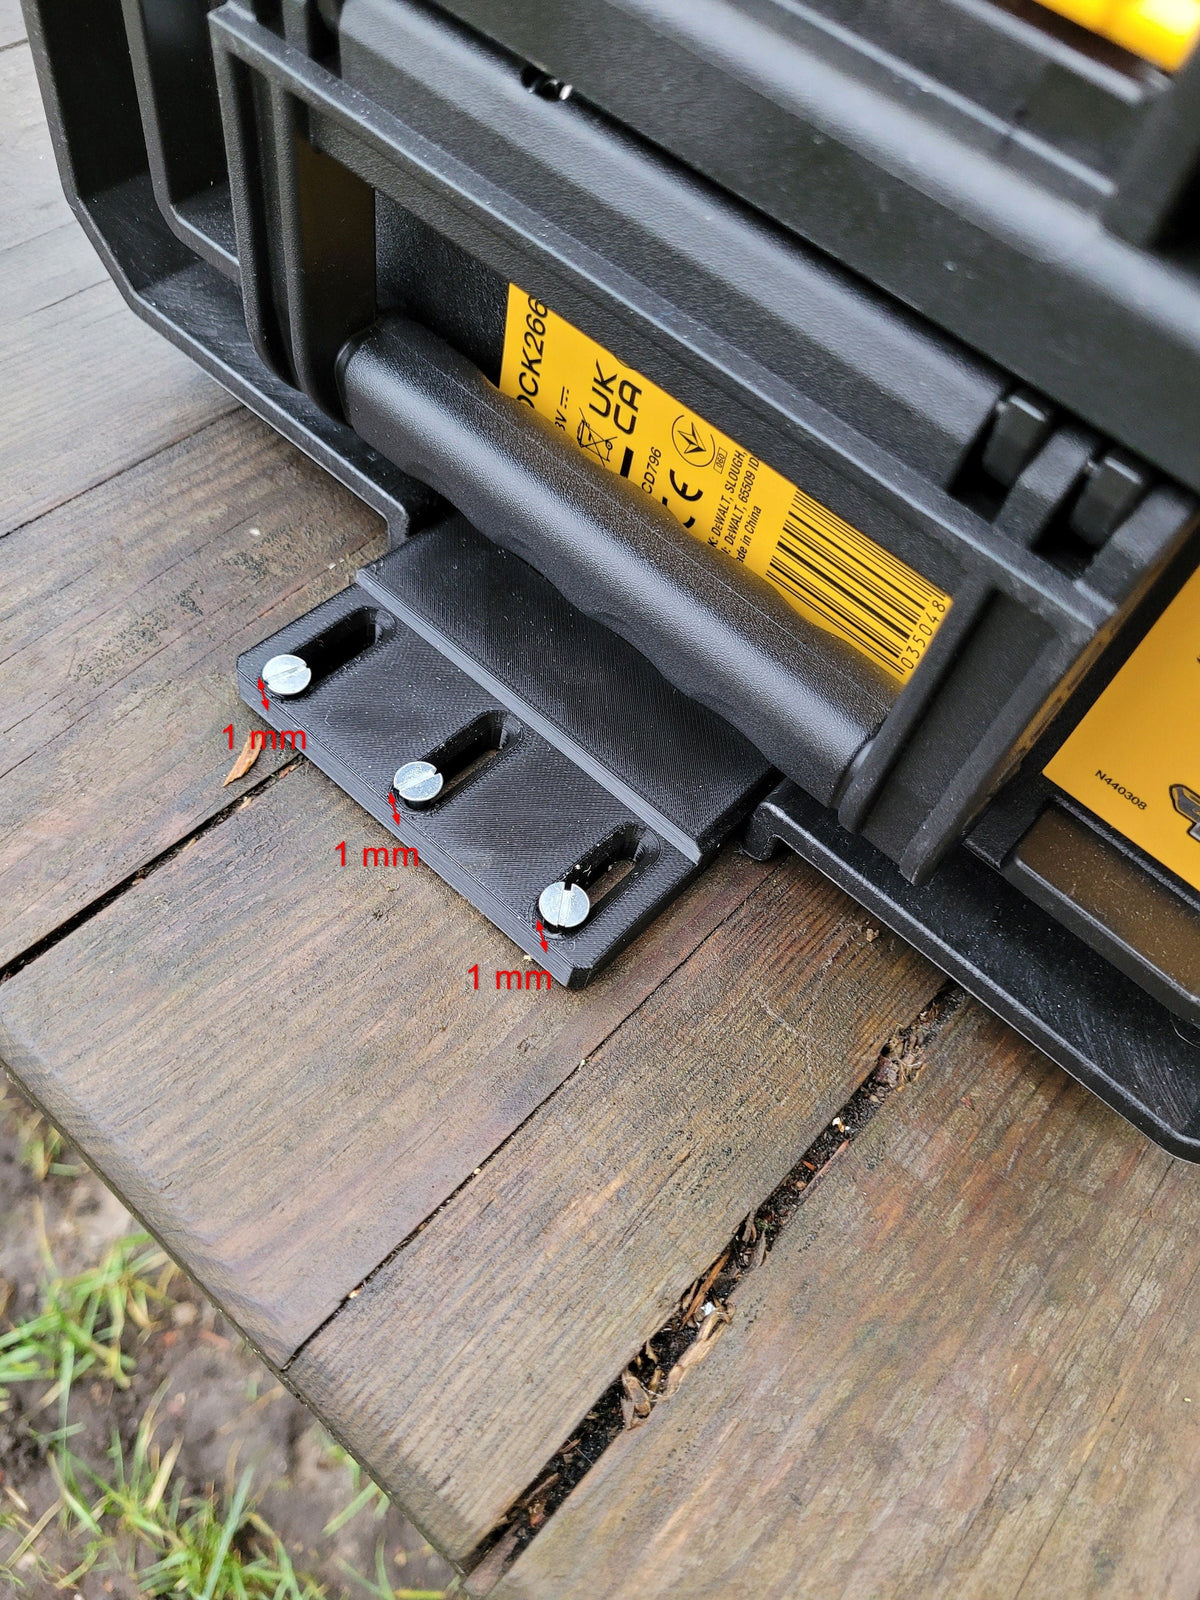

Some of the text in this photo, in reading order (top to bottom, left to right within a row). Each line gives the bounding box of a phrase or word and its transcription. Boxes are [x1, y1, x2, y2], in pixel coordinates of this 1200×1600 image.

[589, 359, 618, 418] UK
[613, 379, 642, 435] CA
[641, 446, 663, 494] CD796
[725, 449, 748, 495] SLOUGH,
[738, 471, 756, 504] 65509
[740, 533, 752, 546] in
[744, 505, 762, 535] China
[901, 600, 946, 670] 035048
[1094, 769, 1148, 811] N440308
